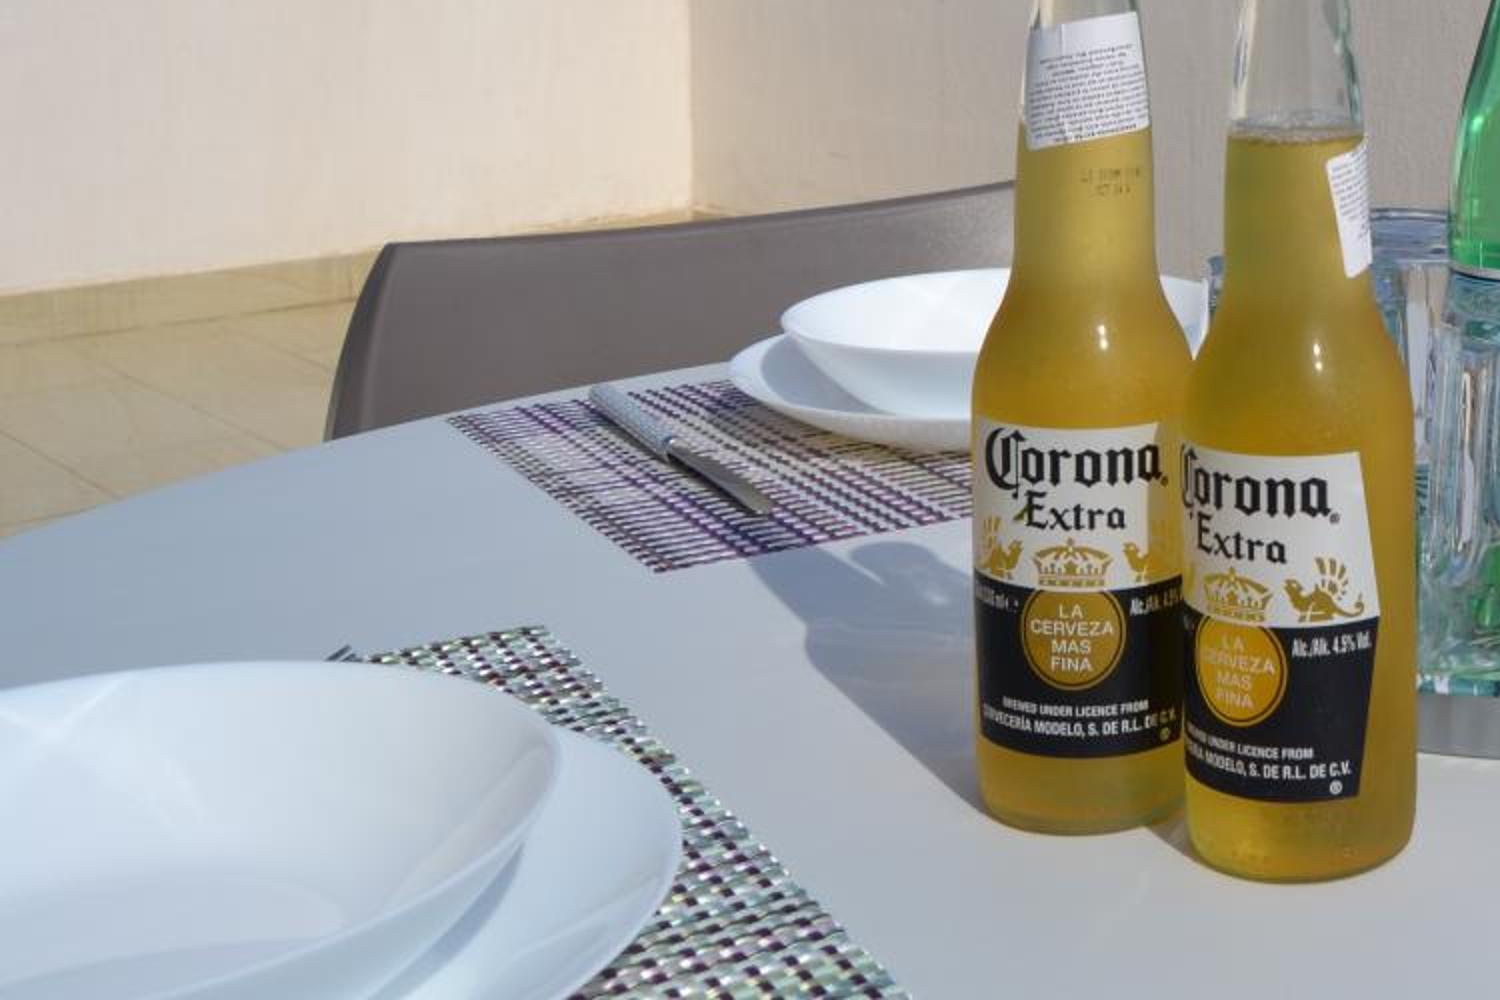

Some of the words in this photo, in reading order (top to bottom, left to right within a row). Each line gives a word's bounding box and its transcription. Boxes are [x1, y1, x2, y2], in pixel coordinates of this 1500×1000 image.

[985, 427, 1163, 499] Corona
[1024, 490, 1126, 531] Extra
[1197, 511, 1288, 565] Extra
[1058, 604, 1084, 619] LA
[1030, 618, 1115, 637] CERVEZA
[1051, 639, 1092, 655] MAS
[1221, 634, 1245, 650] LA
[1051, 656, 1094, 672] FINA
[1214, 670, 1252, 690] MAS
[1039, 703, 1073, 716] UNDER
[1075, 703, 1118, 717] LICENCE
[1120, 699, 1150, 715] FROM
[1214, 688, 1255, 709] FINA
[1034, 721, 1086, 739] MODELO,
[1088, 721, 1100, 736] S.
[1102, 721, 1120, 736] DE
[1121, 717, 1143, 733] R.L.
[1144, 712, 1158, 729] DE
[1237, 743, 1280, 759] LICENCE
[1281, 748, 1314, 761] FROM
[1205, 751, 1248, 777] MODELO,
[1249, 763, 1261, 777] S.
[1263, 764, 1280, 780] DE
[1282, 765, 1307, 780] R.L.
[1309, 763, 1327, 779] DE
[1329, 760, 1352, 777] C.V.
